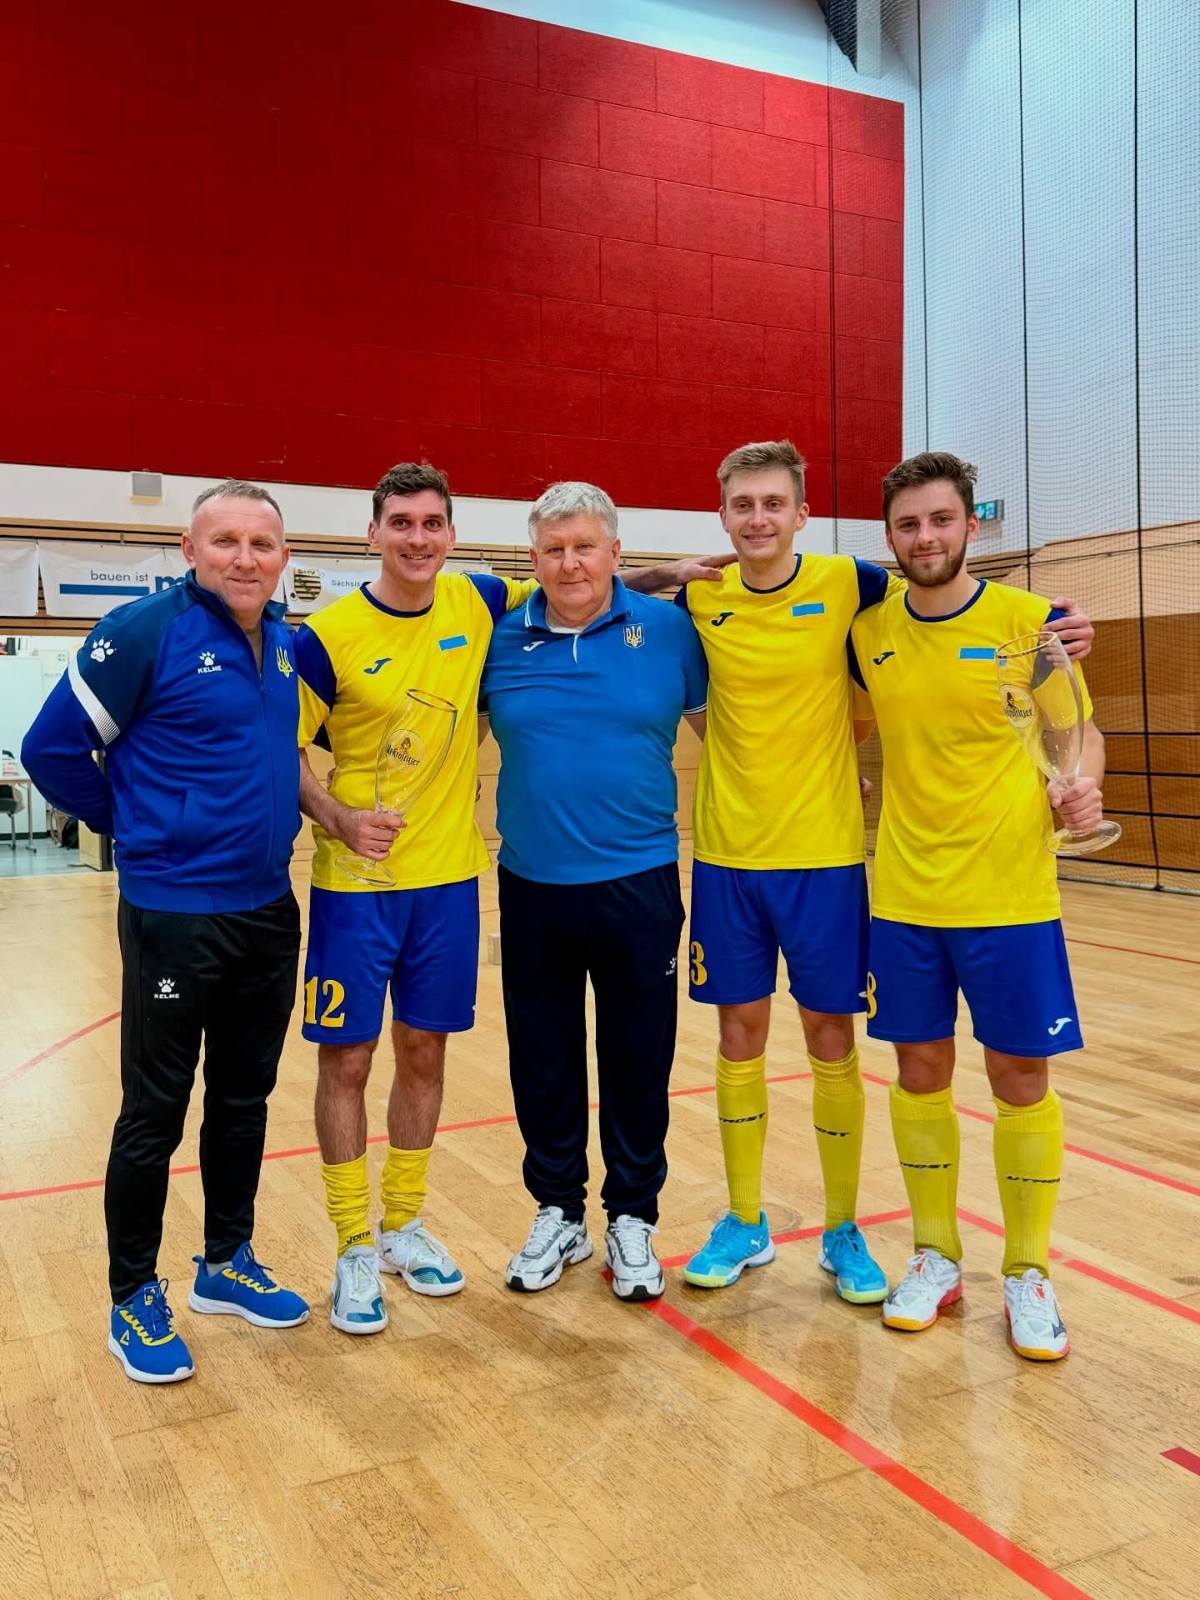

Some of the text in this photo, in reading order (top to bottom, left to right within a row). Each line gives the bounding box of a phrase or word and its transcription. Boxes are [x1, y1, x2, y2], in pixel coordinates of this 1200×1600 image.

[90, 569, 149, 582] bauen ist
[197, 665, 223, 674] KELME
[304, 976, 346, 1028] 12
